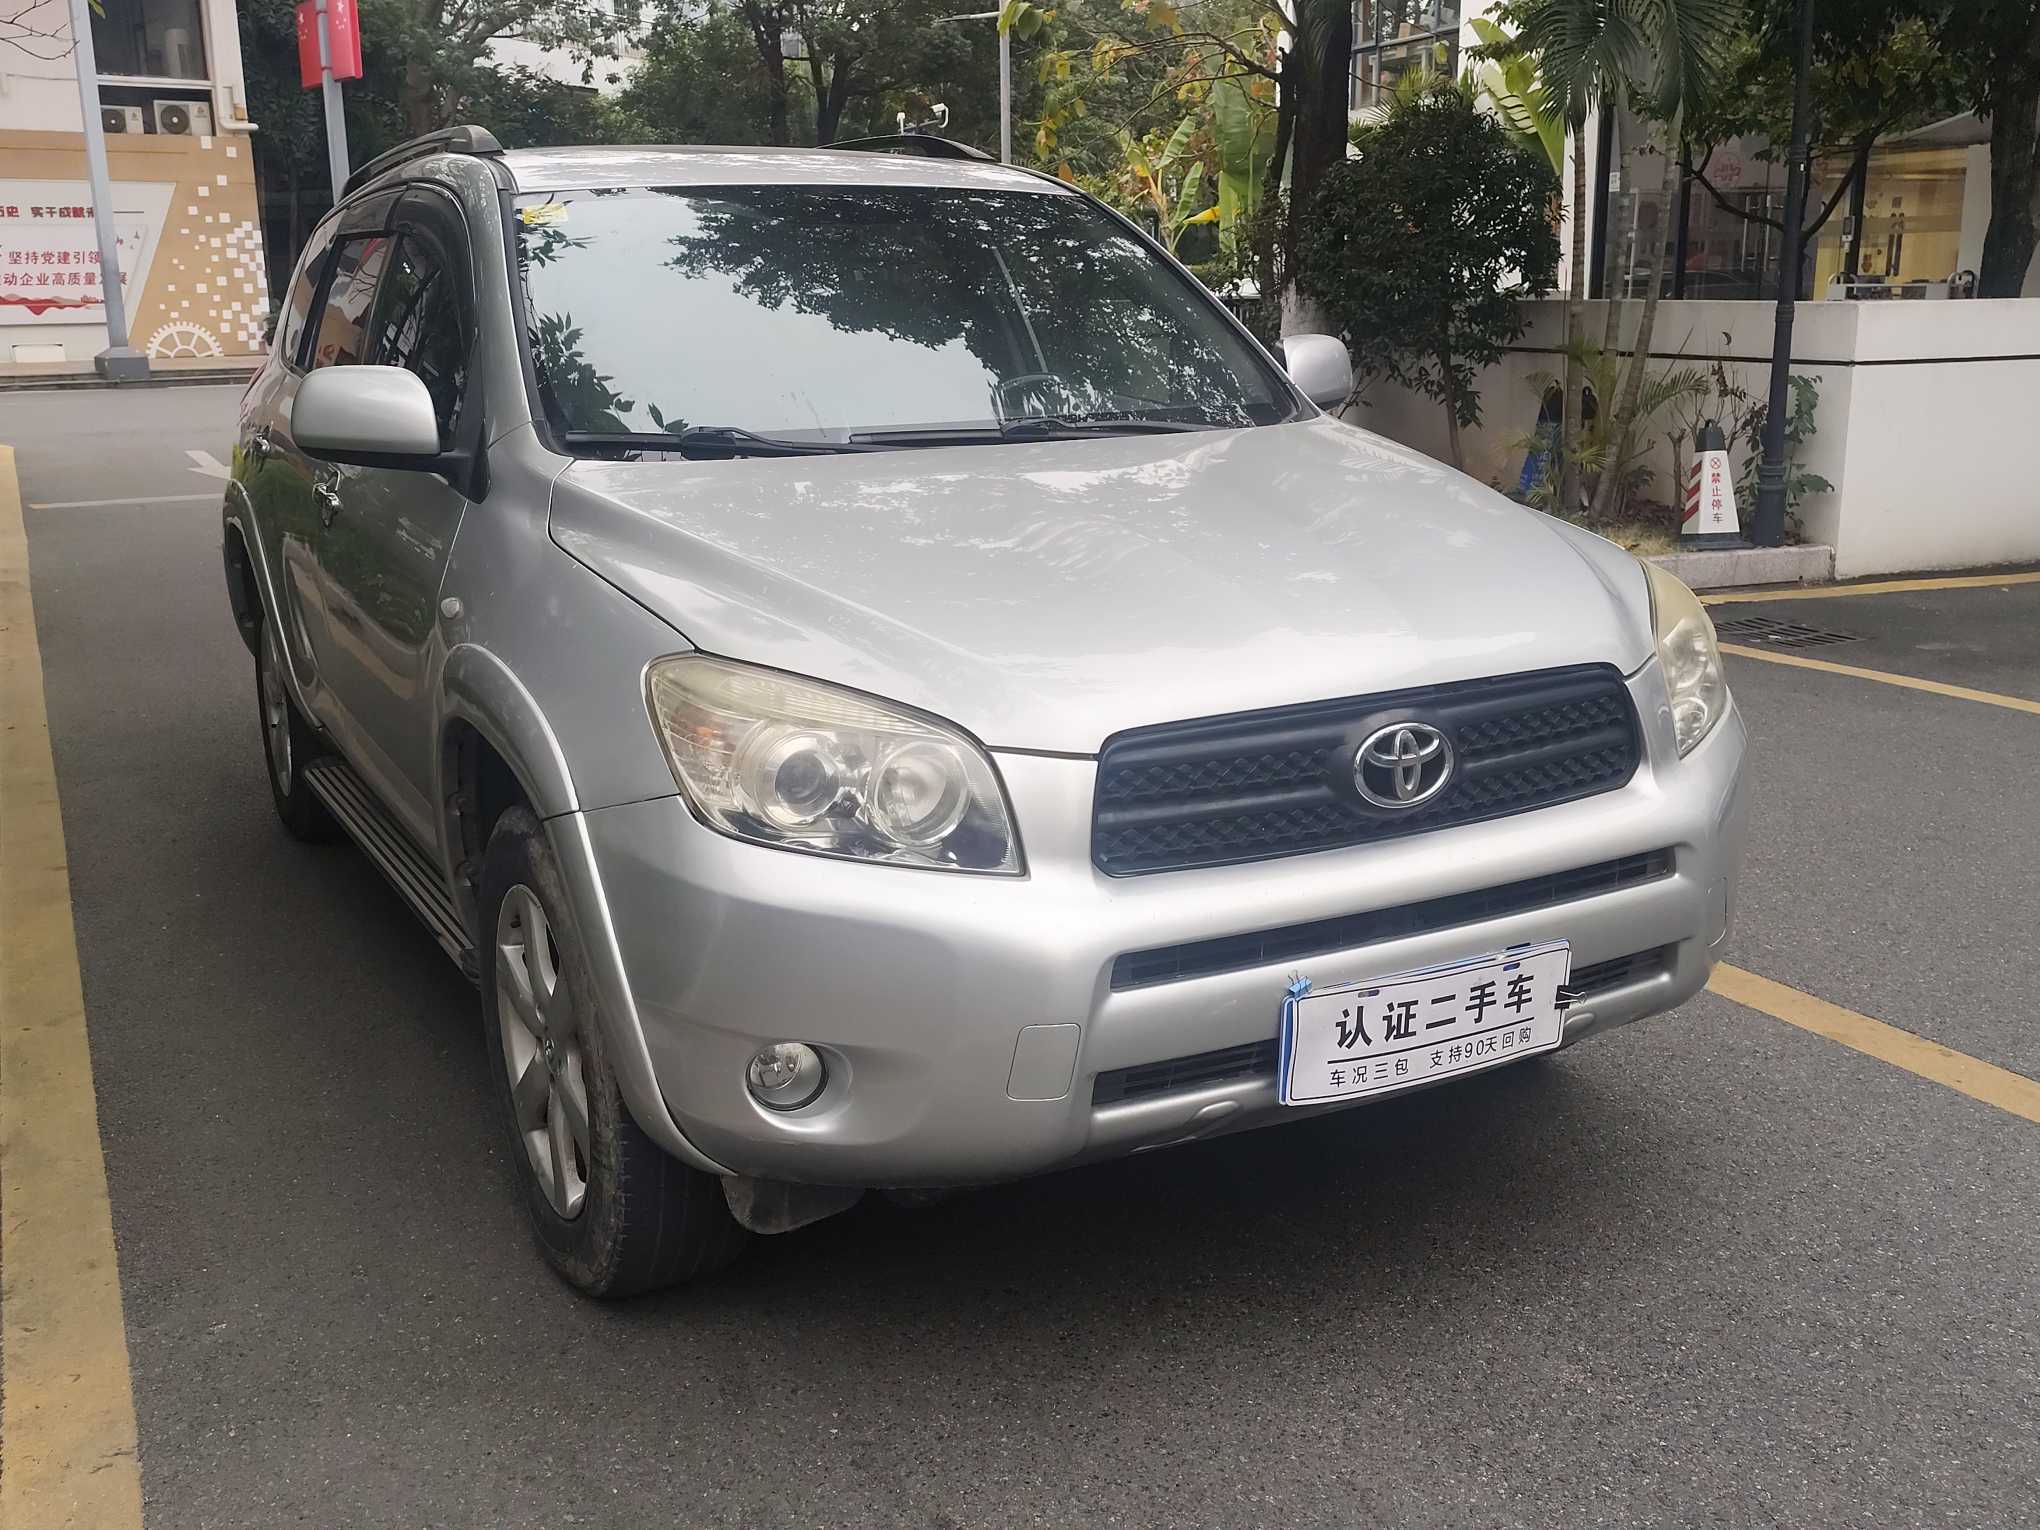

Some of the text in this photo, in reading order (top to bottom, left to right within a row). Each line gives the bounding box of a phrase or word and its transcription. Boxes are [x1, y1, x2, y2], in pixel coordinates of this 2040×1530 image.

[0, 271, 128, 286] 动企业高质量展
[8, 251, 102, 265] 坚持党建引领
[1711, 472, 1724, 524] 禁止停车
[1335, 973, 1534, 1050] 认证二手车
[1329, 1025, 1532, 1088] 车况三包 支持90天回购
